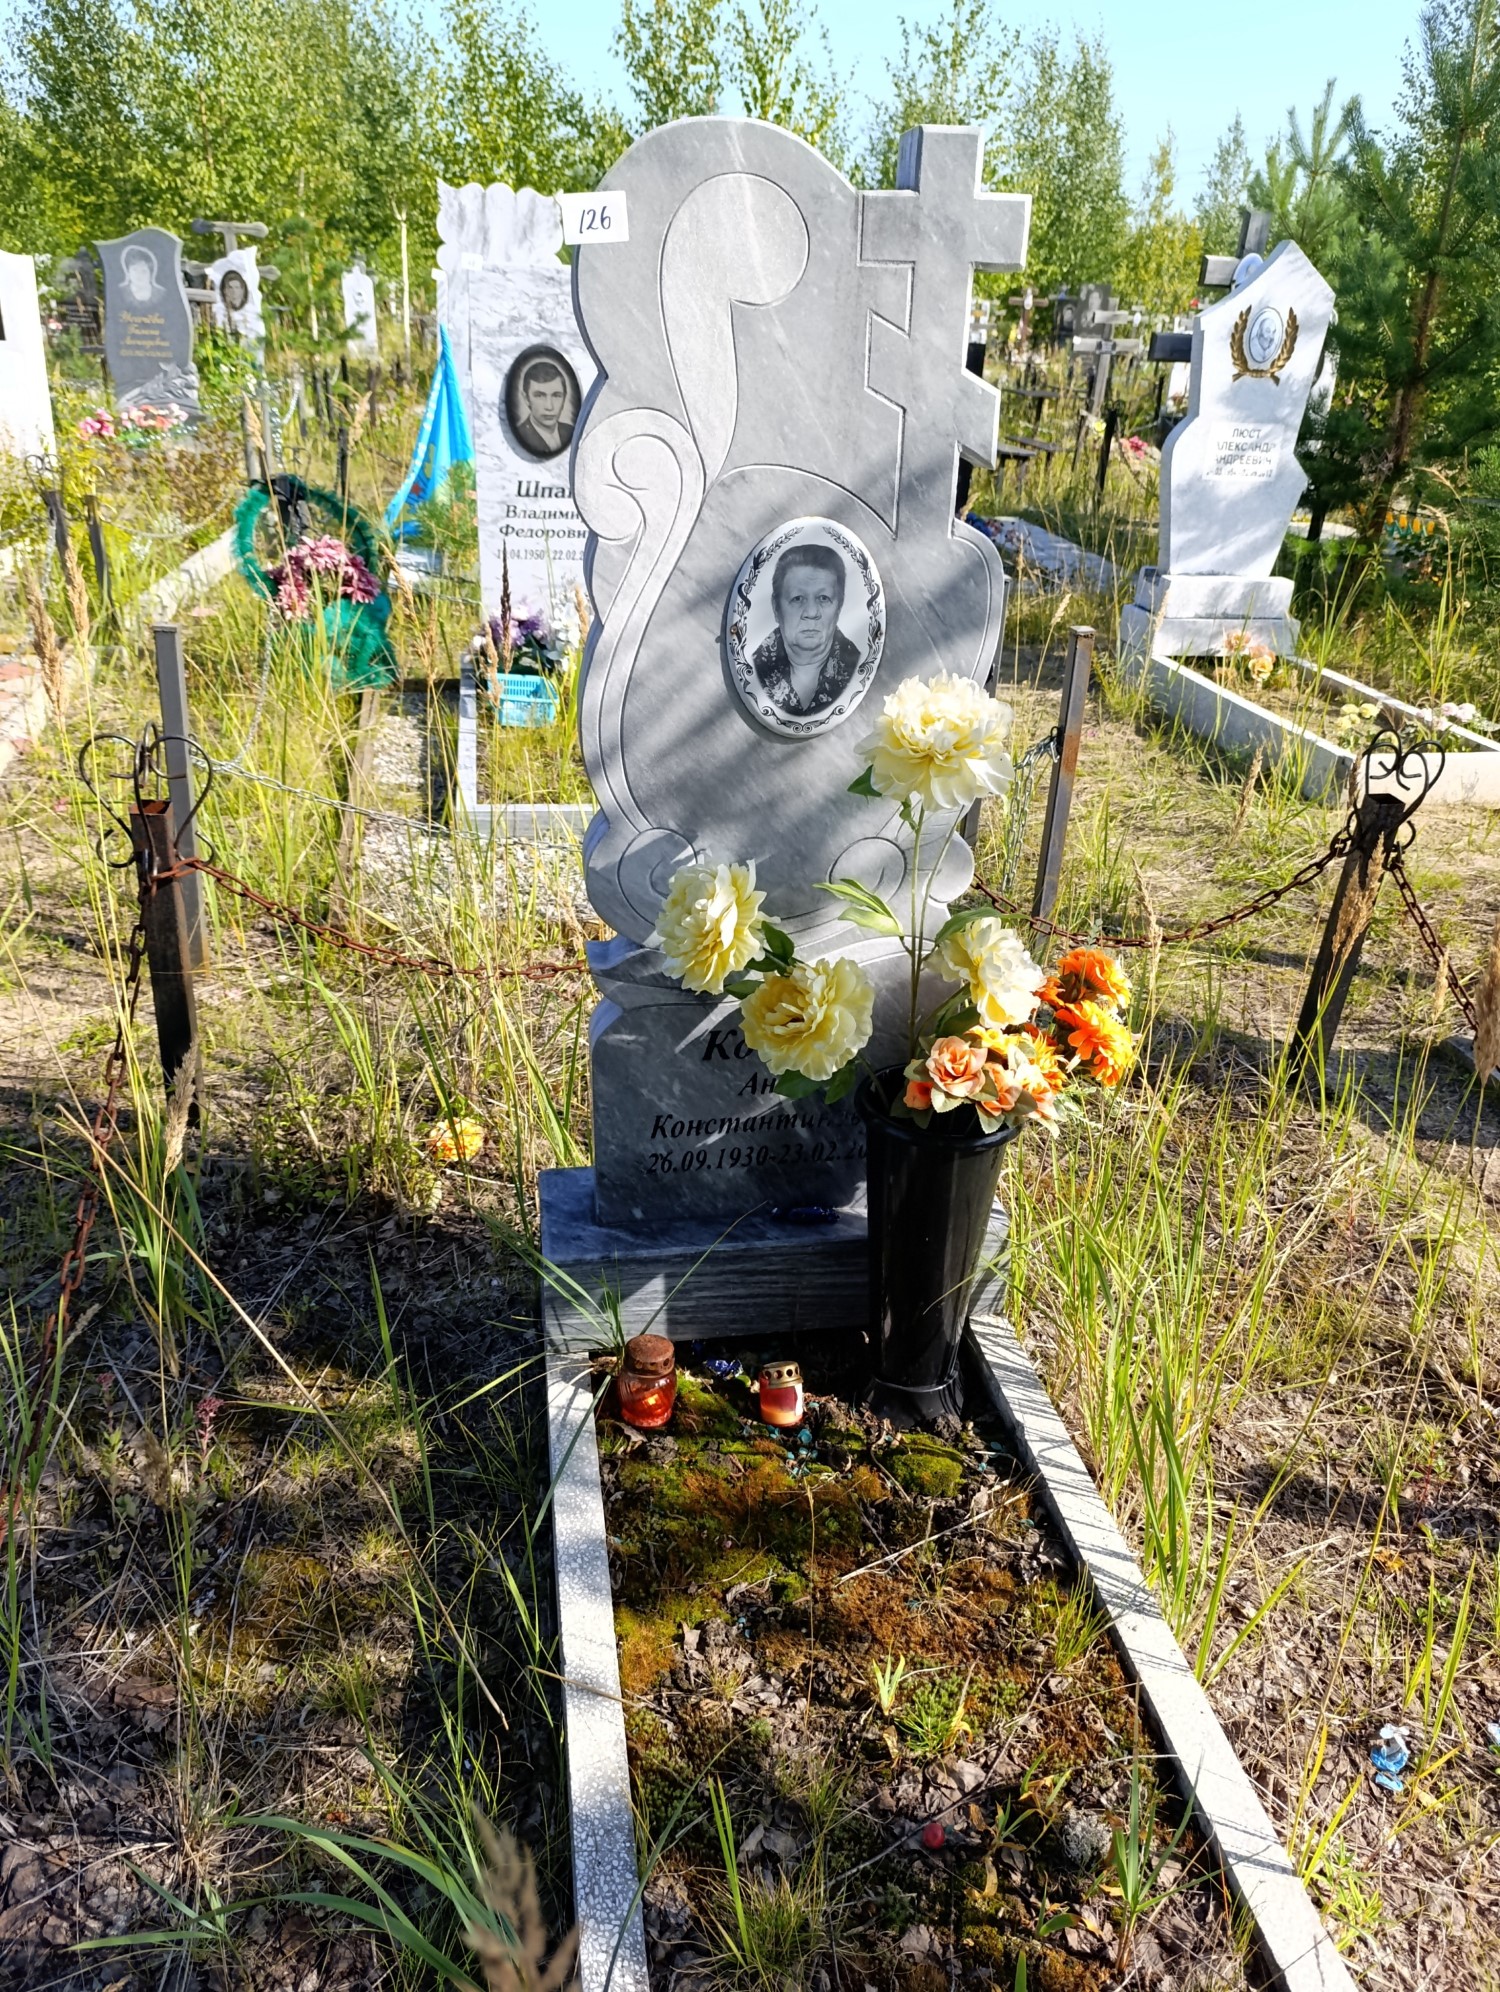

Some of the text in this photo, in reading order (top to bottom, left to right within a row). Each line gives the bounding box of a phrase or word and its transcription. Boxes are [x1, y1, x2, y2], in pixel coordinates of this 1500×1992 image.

[579, 205, 612, 235] 126
[516, 480, 573, 499] Шпа
[505, 504, 581, 521] Владими
[499, 524, 588, 539] Федорови
